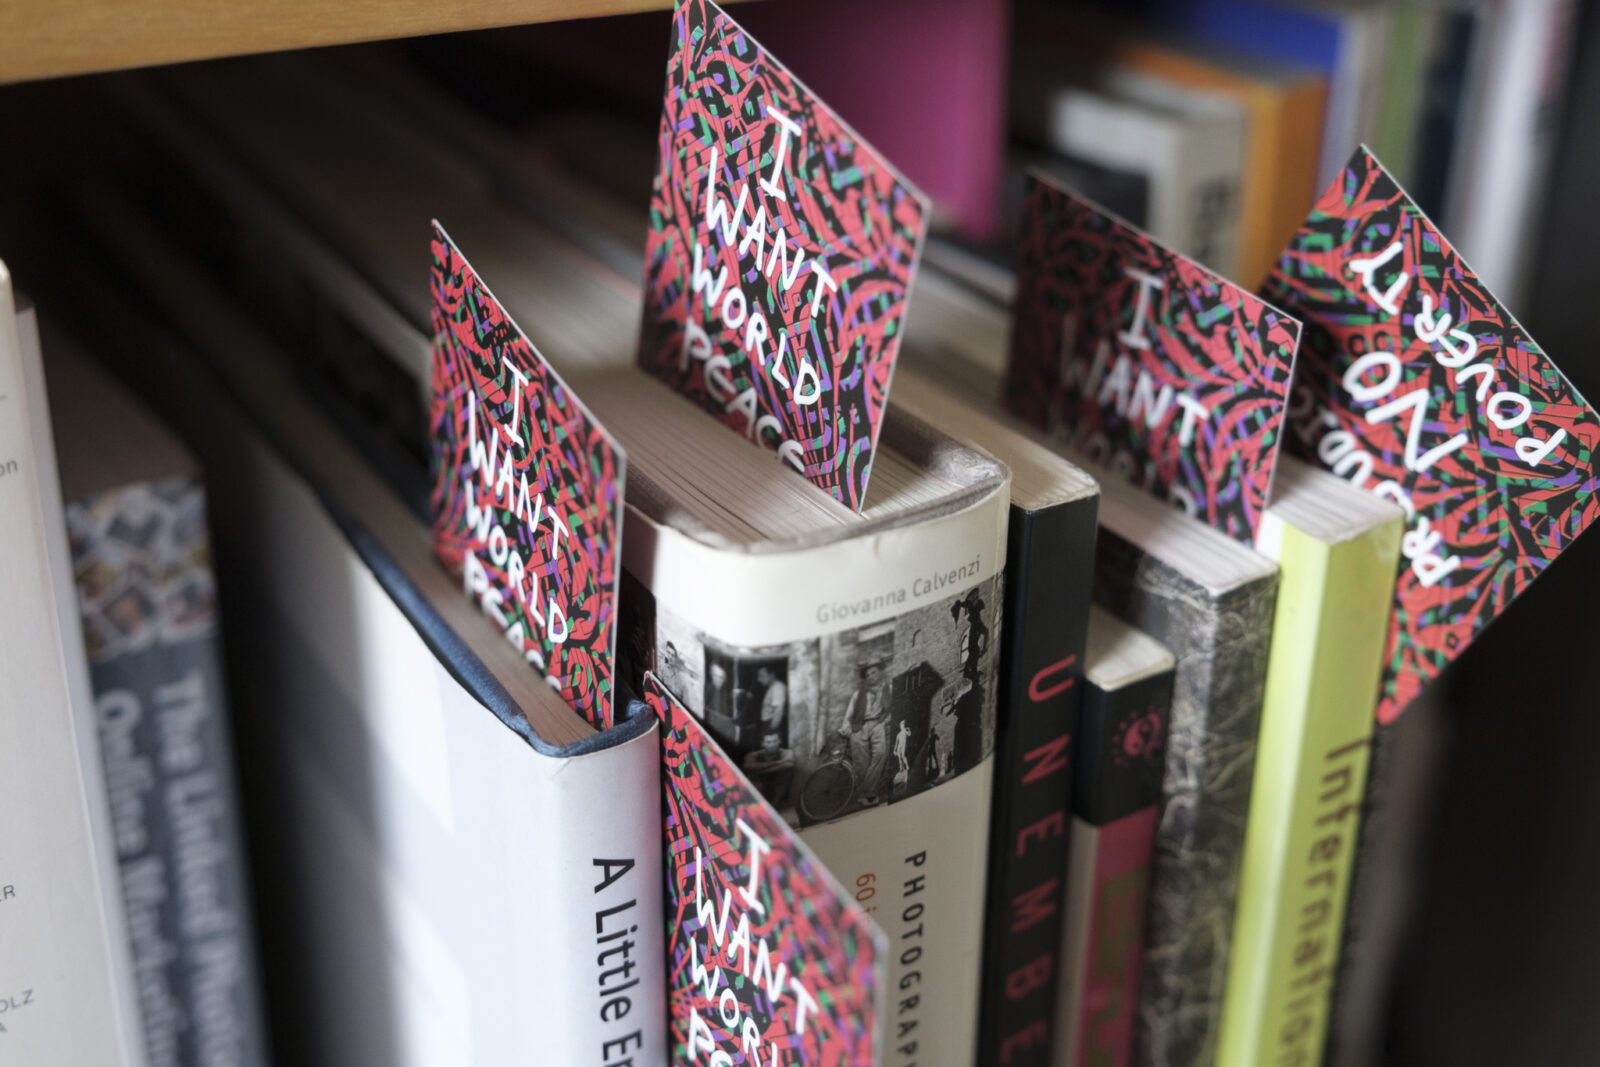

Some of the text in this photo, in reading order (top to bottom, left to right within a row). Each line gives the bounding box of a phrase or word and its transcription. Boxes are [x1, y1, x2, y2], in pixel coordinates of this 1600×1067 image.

[766, 105, 802, 202] I
[705, 146, 838, 318] WANT
[692, 243, 821, 405] WORLD
[1118, 266, 1166, 350] I
[1349, 241, 1567, 467] POVERTY
[502, 355, 529, 449] I
[679, 316, 806, 473] PEACE
[1061, 312, 1210, 448] WANT
[1343, 350, 1468, 473] NO
[468, 389, 569, 560] WANT
[465, 480, 569, 644] WORLD
[816, 554, 982, 624] Giovanna Calvenzi
[592, 857, 636, 894] A
[735, 817, 771, 916] I
[855, 872, 877, 902] 60
[594, 898, 641, 1023] Little
[696, 846, 819, 1035] WANT
[897, 850, 927, 1067] PHOTOGRAP
